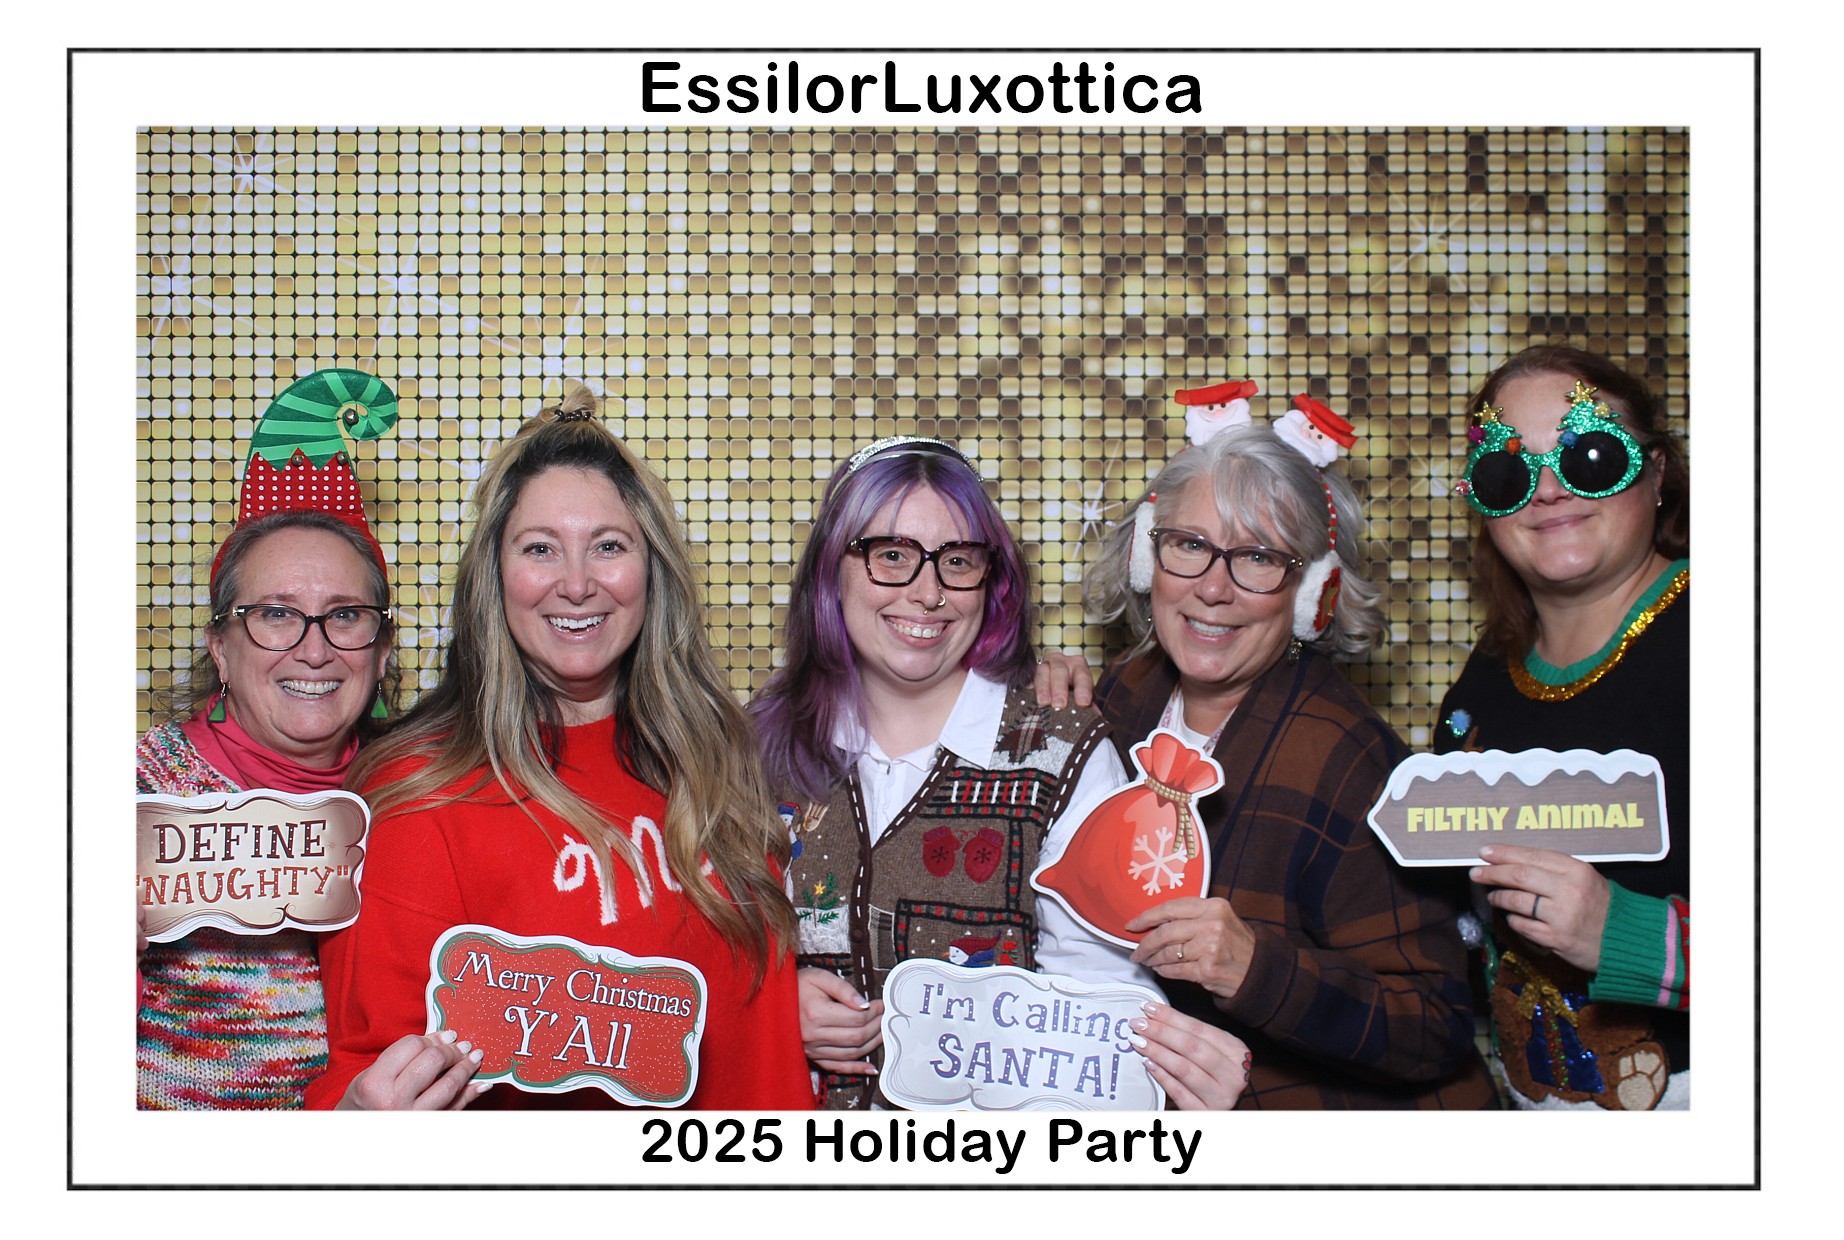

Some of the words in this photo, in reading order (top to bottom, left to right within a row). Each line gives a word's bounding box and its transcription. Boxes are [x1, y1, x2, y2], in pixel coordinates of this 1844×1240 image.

[153, 819, 327, 863] DEFINE
[1407, 806, 1509, 832] FILTHY
[454, 951, 555, 1006] Merry
[566, 969, 693, 1017] Christmas
[919, 983, 976, 1022] I'm
[504, 1005, 632, 1070] Y'All
[929, 1033, 1120, 1100] SANTA!
